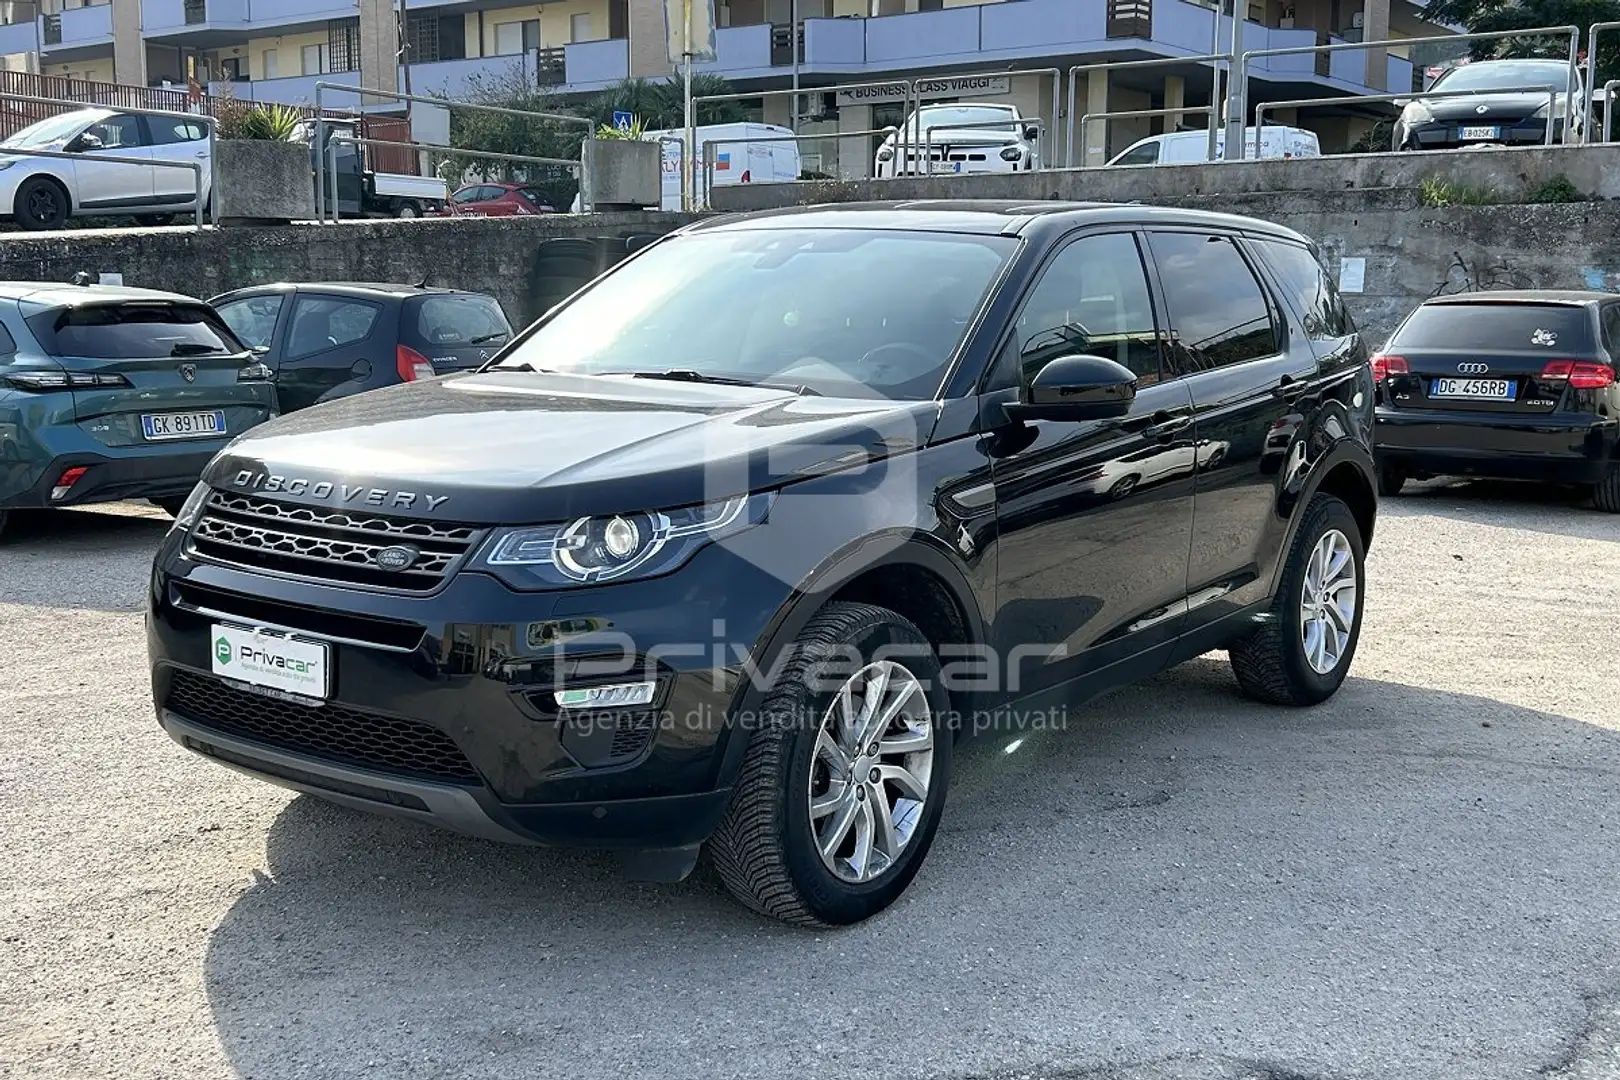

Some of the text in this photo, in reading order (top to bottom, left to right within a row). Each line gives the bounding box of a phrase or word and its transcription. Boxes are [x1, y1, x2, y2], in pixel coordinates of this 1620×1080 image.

[856, 84, 906, 99] BUSINESS
[911, 80, 948, 94] CLASS
[952, 77, 991, 91] VIAGGI
[1440, 380, 1507, 395] DG 456RB
[153, 415, 216, 434] GK 891TD
[234, 470, 449, 512] DISCOVERY
[240, 645, 316, 674] Privacar
